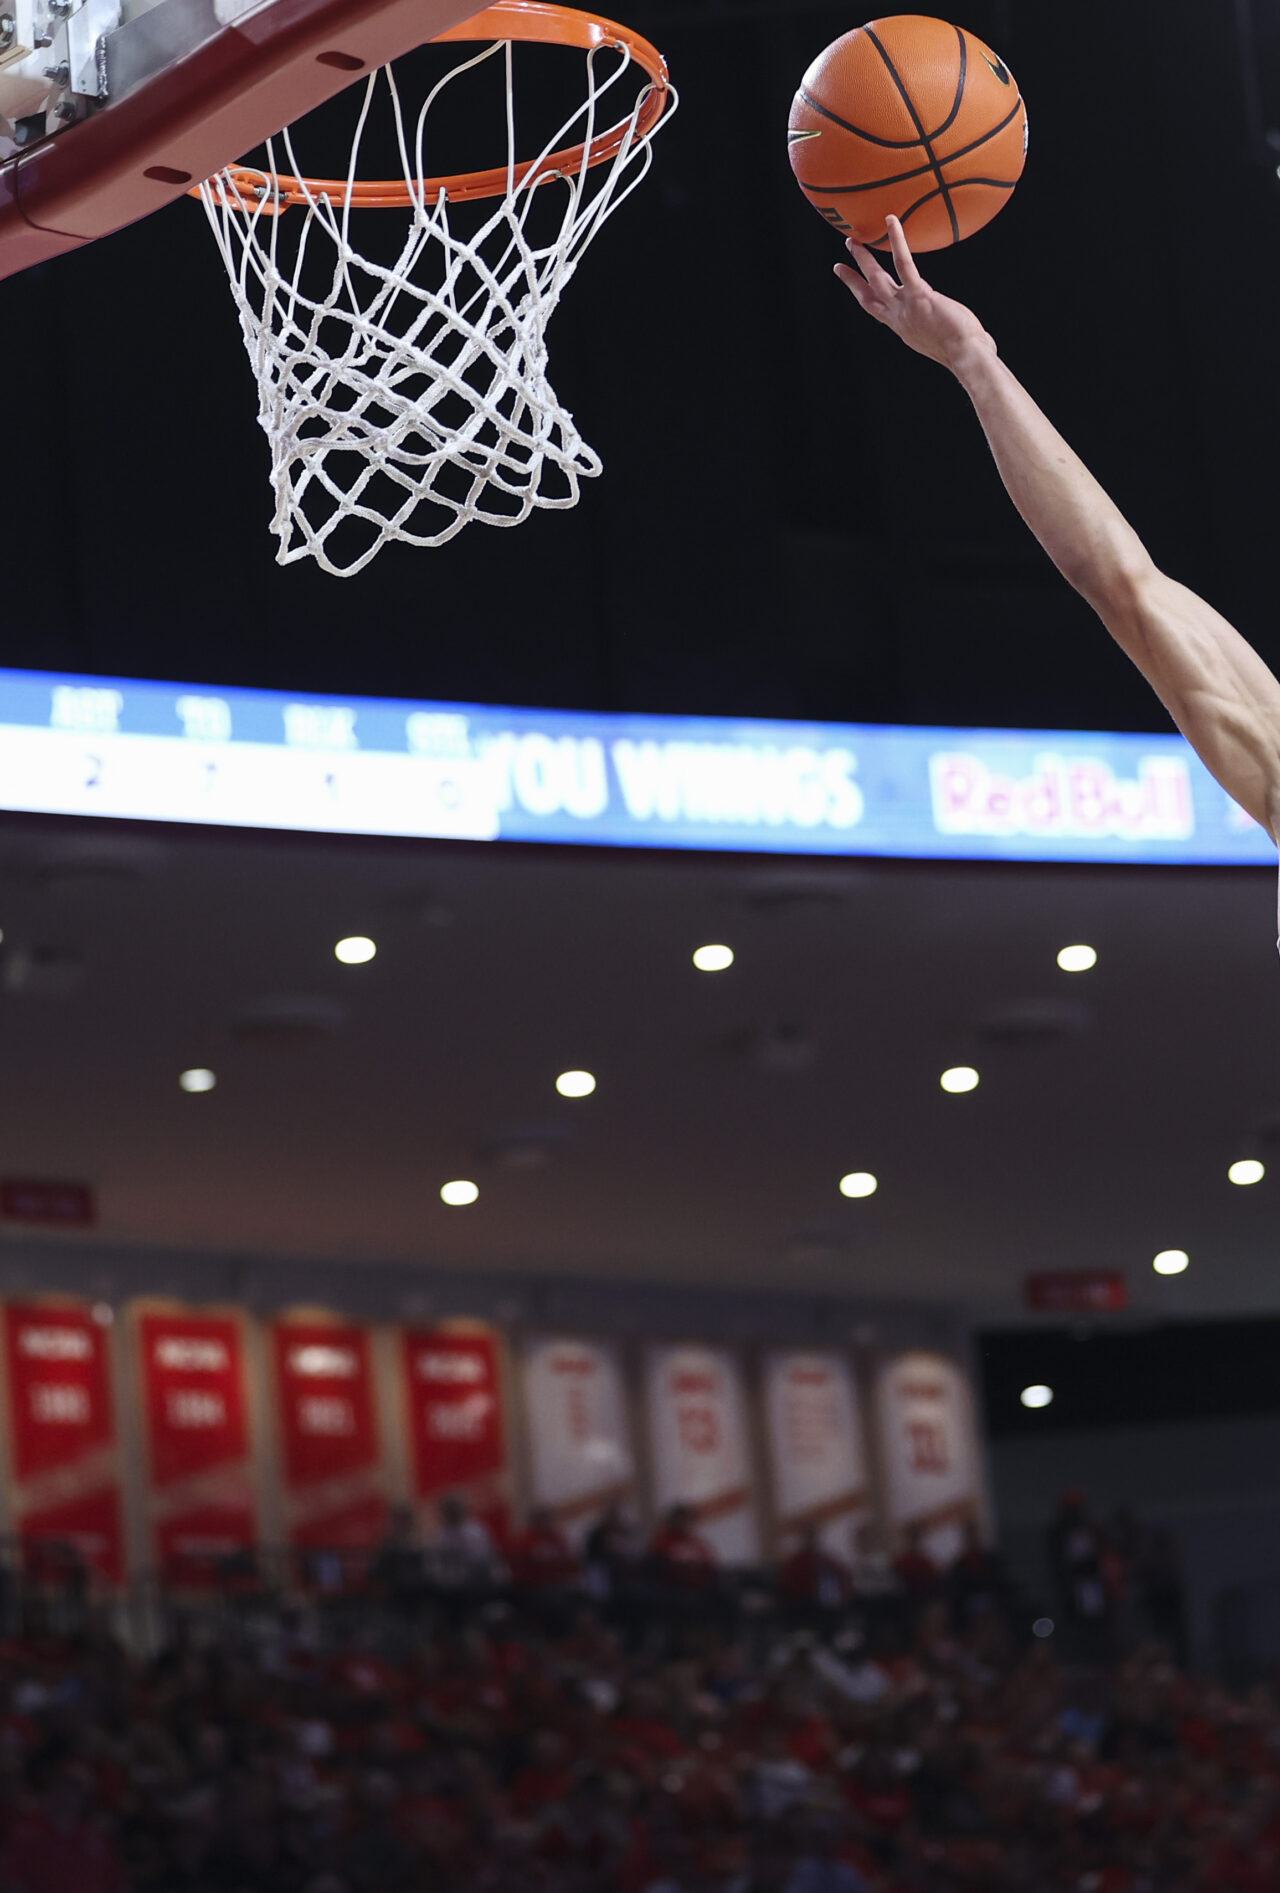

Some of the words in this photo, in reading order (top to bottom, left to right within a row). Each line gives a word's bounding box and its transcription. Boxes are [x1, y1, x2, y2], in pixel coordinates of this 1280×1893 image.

[612, 737, 865, 829] WINGS
[929, 752, 1066, 836] Red
[1066, 754, 1195, 840] Bull
